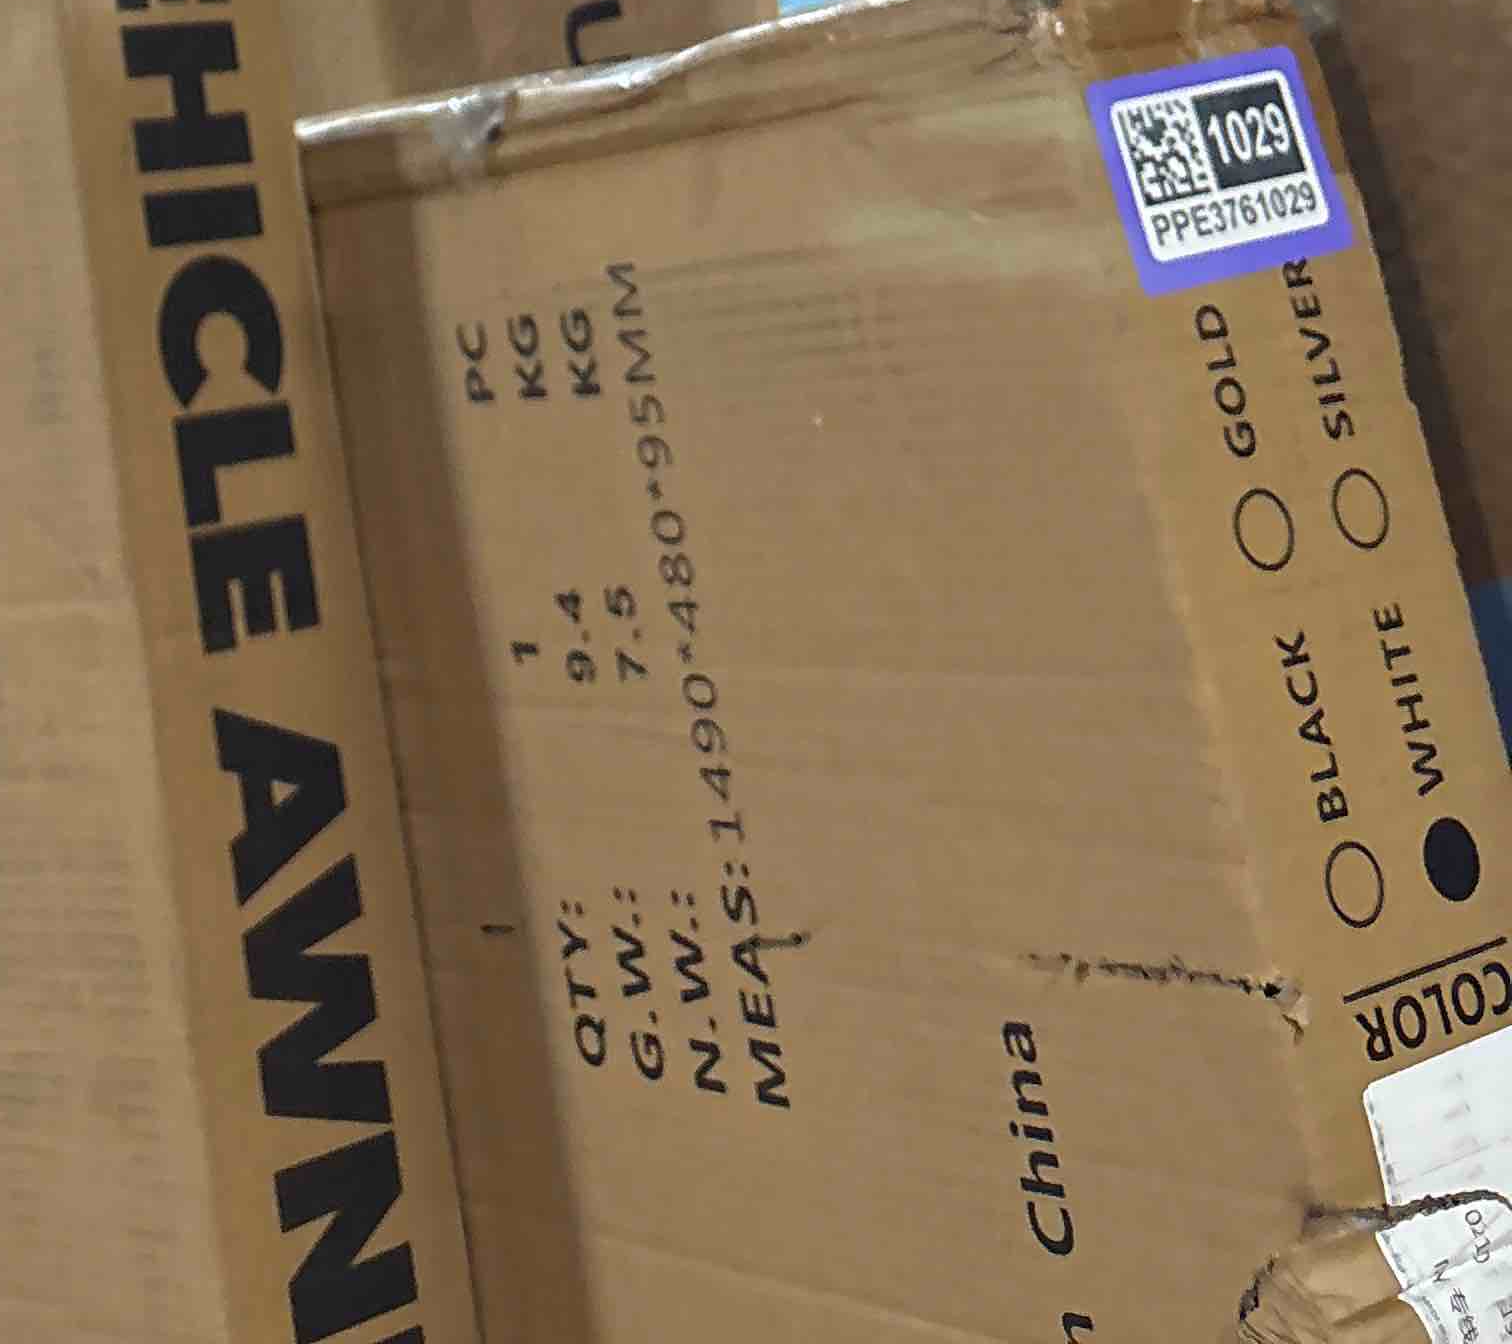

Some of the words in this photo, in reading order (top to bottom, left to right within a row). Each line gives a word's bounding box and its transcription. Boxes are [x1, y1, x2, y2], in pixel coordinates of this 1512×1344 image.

[1207, 101, 1290, 164] 1029
[1150, 180, 1317, 247] PPE3761029
[456, 322, 495, 404] PC
[507, 313, 549, 401] KG
[560, 308, 602, 397] KG
[1196, 304, 1257, 458] GOLD
[1281, 257, 1355, 441] SILVER
[509, 640, 541, 665] 1
[554, 588, 598, 684] 9.4
[603, 584, 649, 683] 7.5
[1275, 630, 1348, 823] BLACK
[1372, 601, 1445, 797] WHITE
[212, 707, 426, 1344] AWN
[556, 898, 606, 1067] QTY:
[1354, 961, 1512, 1062] COLOR
[1002, 1020, 1075, 1256] China
